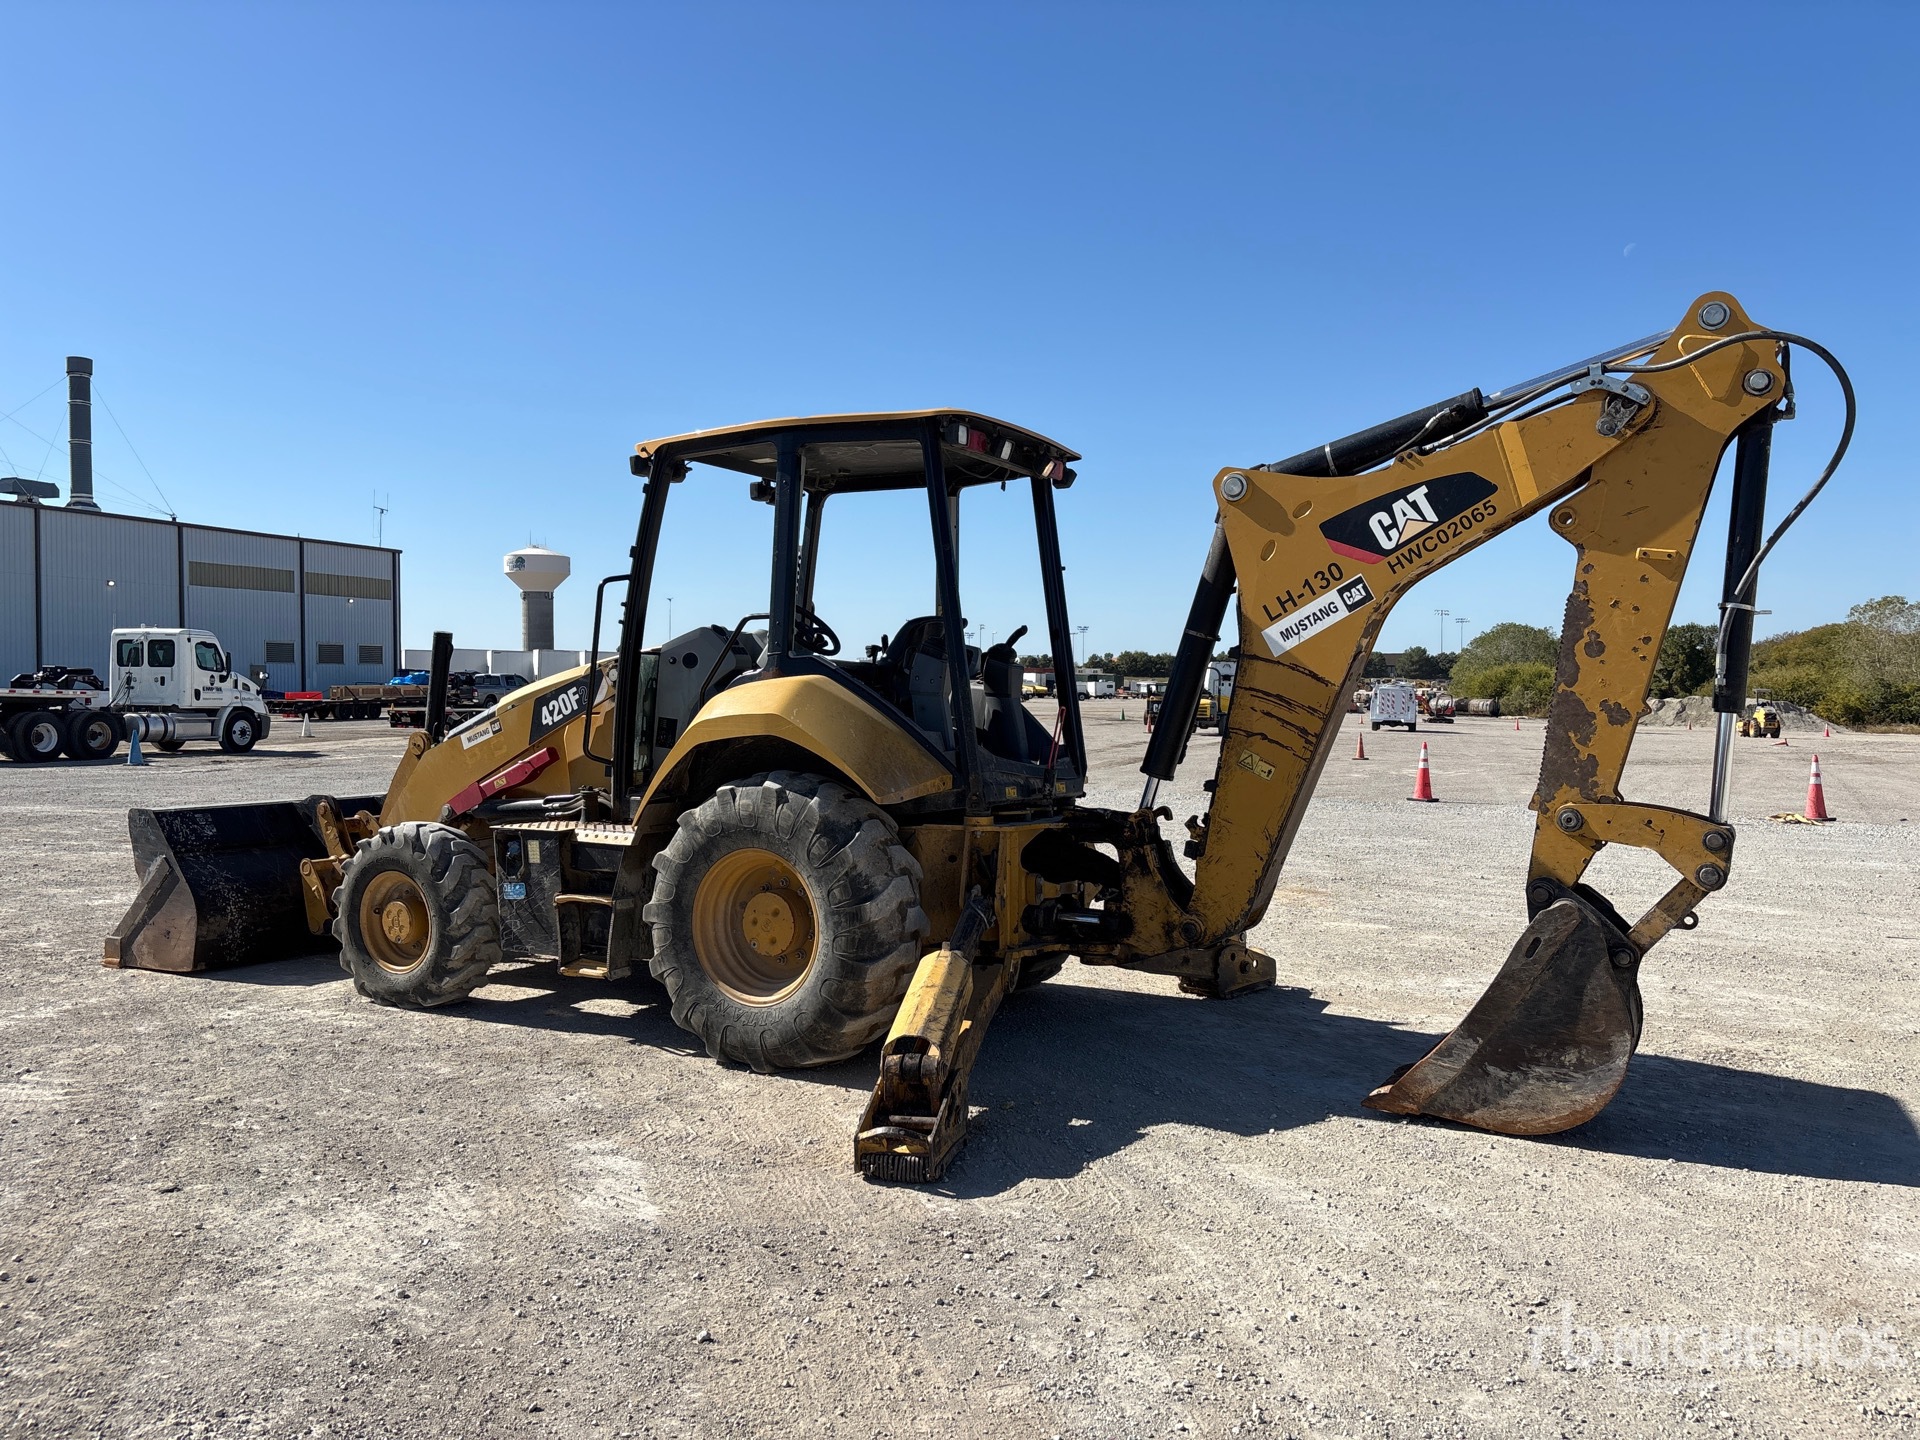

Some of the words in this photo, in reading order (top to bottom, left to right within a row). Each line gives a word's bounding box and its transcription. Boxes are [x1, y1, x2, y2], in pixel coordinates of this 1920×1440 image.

[1368, 485, 1439, 550] CAT
[1387, 500, 1498, 575] HWC02065
[1262, 562, 1344, 623] LH-130
[1279, 601, 1340, 643] MUSTANG
[1342, 583, 1367, 606] CAT
[466, 727, 490, 743] MUSTANG
[491, 721, 501, 732] CAT
[714, 999, 784, 1027] TITAN
